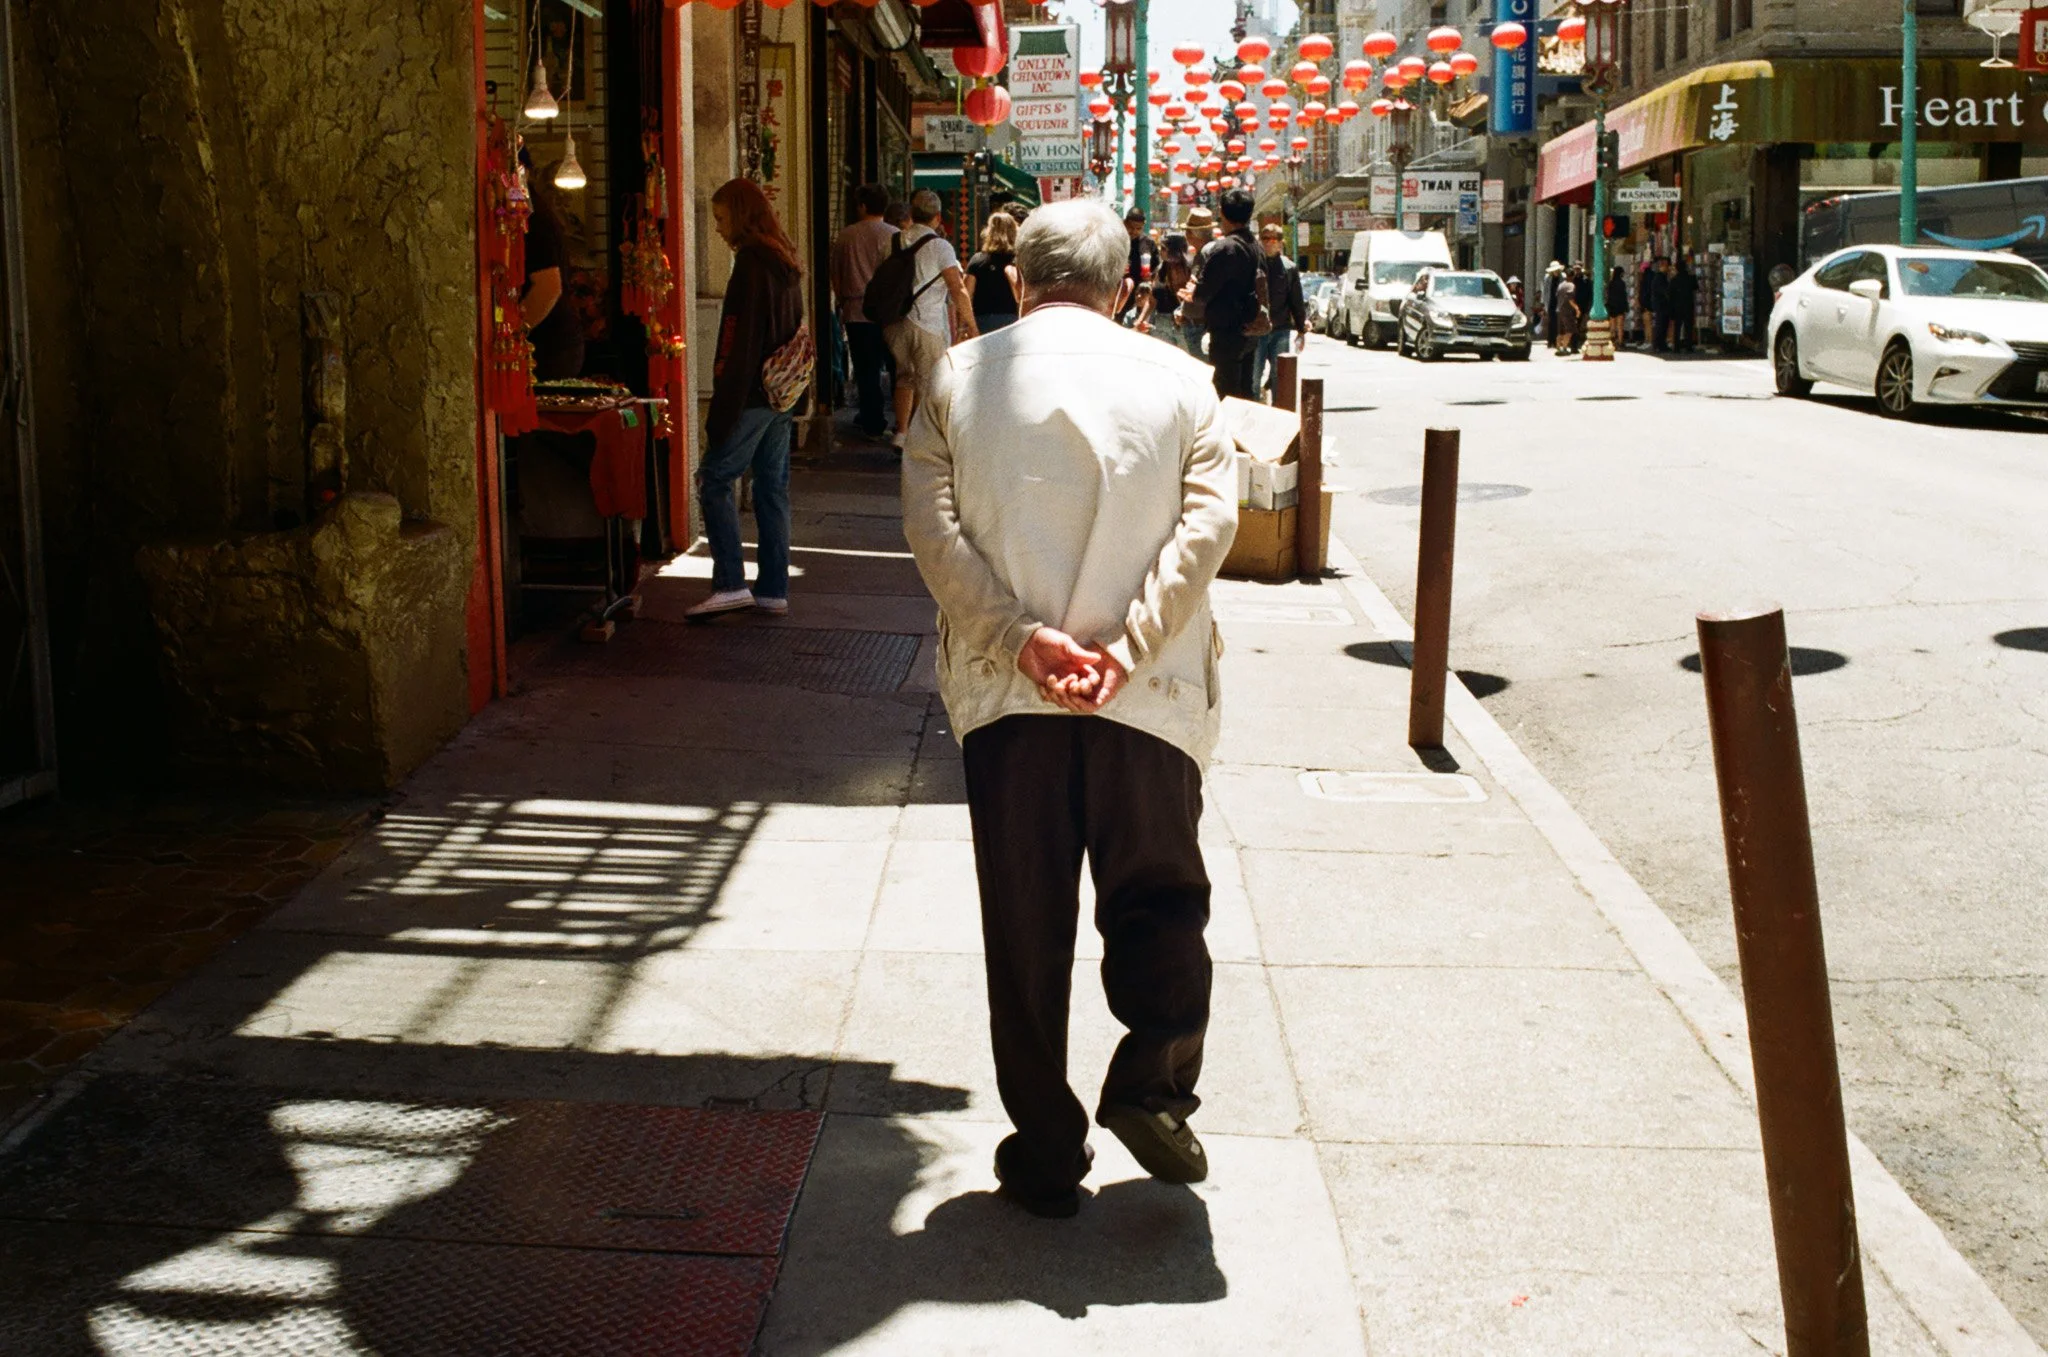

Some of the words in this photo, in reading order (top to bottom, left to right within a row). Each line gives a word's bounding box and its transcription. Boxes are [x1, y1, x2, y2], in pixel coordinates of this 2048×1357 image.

[1018, 58, 1049, 70] ONLY
[1052, 58, 1066, 69] IN
[1012, 70, 1071, 82] CHINATOWN
[1016, 103, 1051, 116] GIFTS
[1054, 102, 1067, 114] &
[1709, 83, 1739, 141] 上海
[1879, 86, 2025, 127] Heart
[1015, 119, 1069, 130] SOUVENIR
[1421, 180, 1452, 191] TWAN
[1459, 180, 1478, 191] KEE
[1620, 190, 1679, 199] WASHINGTON
